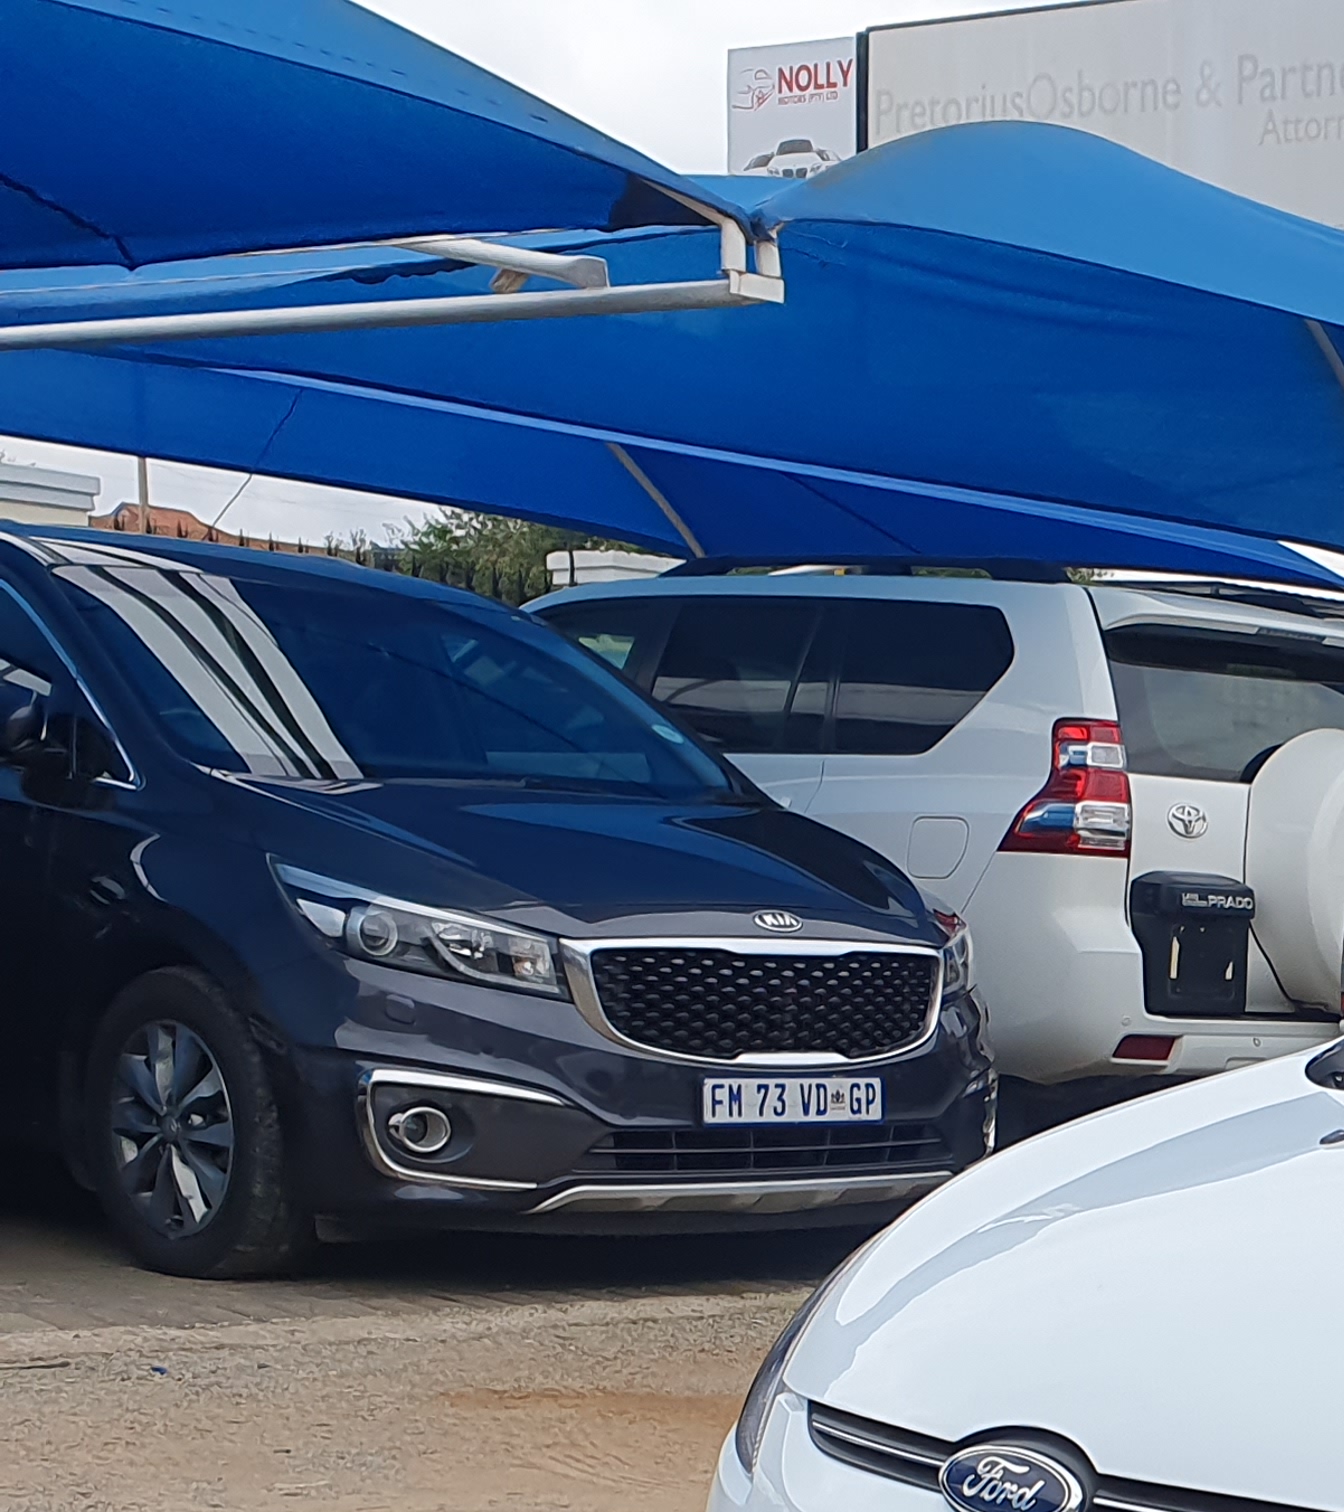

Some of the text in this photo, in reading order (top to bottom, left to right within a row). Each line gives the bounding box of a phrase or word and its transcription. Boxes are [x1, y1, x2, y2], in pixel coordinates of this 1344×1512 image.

[777, 58, 853, 94] NOLLY
[1195, 59, 1222, 108] &
[763, 912, 798, 927] KIA
[1207, 894, 1253, 909] PRADO
[711, 1082, 876, 1118] FM 73 VD GP
[962, 1455, 1046, 1512] Ford
